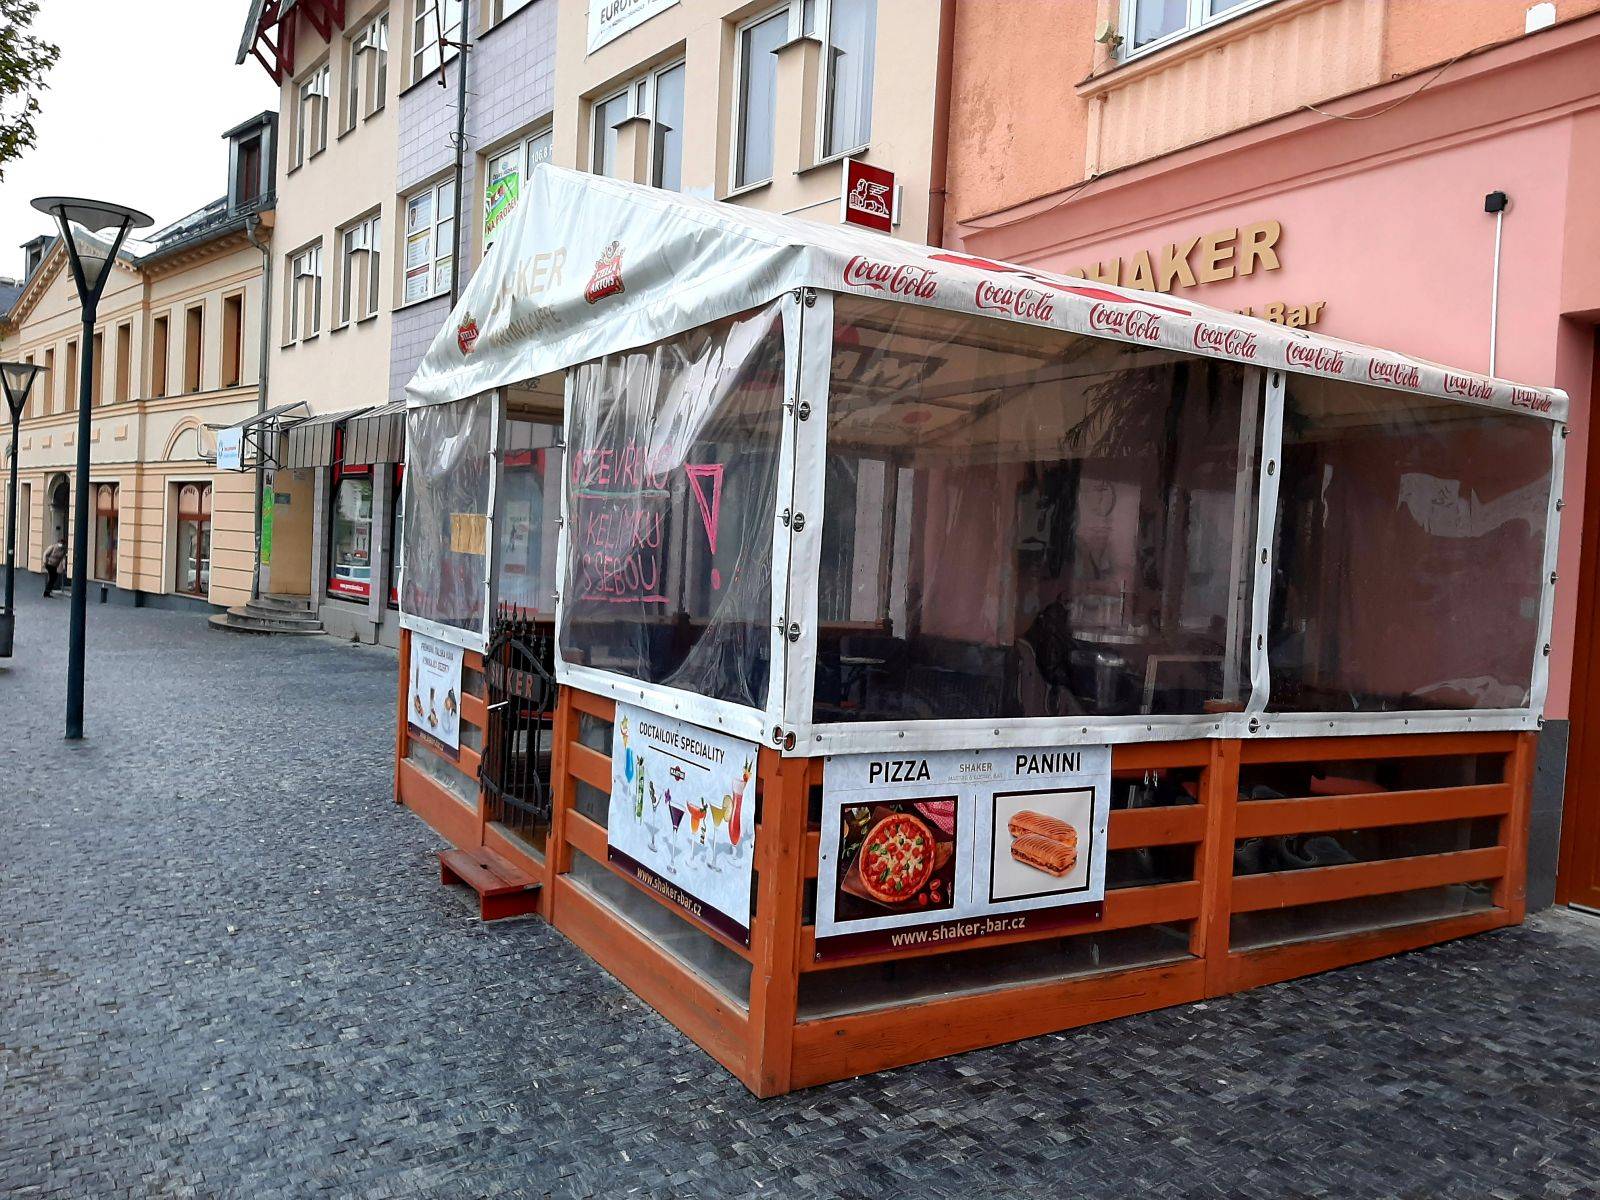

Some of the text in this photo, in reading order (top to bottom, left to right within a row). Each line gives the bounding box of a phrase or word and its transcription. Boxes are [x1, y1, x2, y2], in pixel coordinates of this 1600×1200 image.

[1066, 220, 1281, 293] HAKER
[639, 721, 725, 764] COCTAILOVÉ SPECIALITY
[869, 752, 1081, 783] PIZZA SHAKER PANINI
[892, 915, 1026, 947] www.shaker-bar.cz
